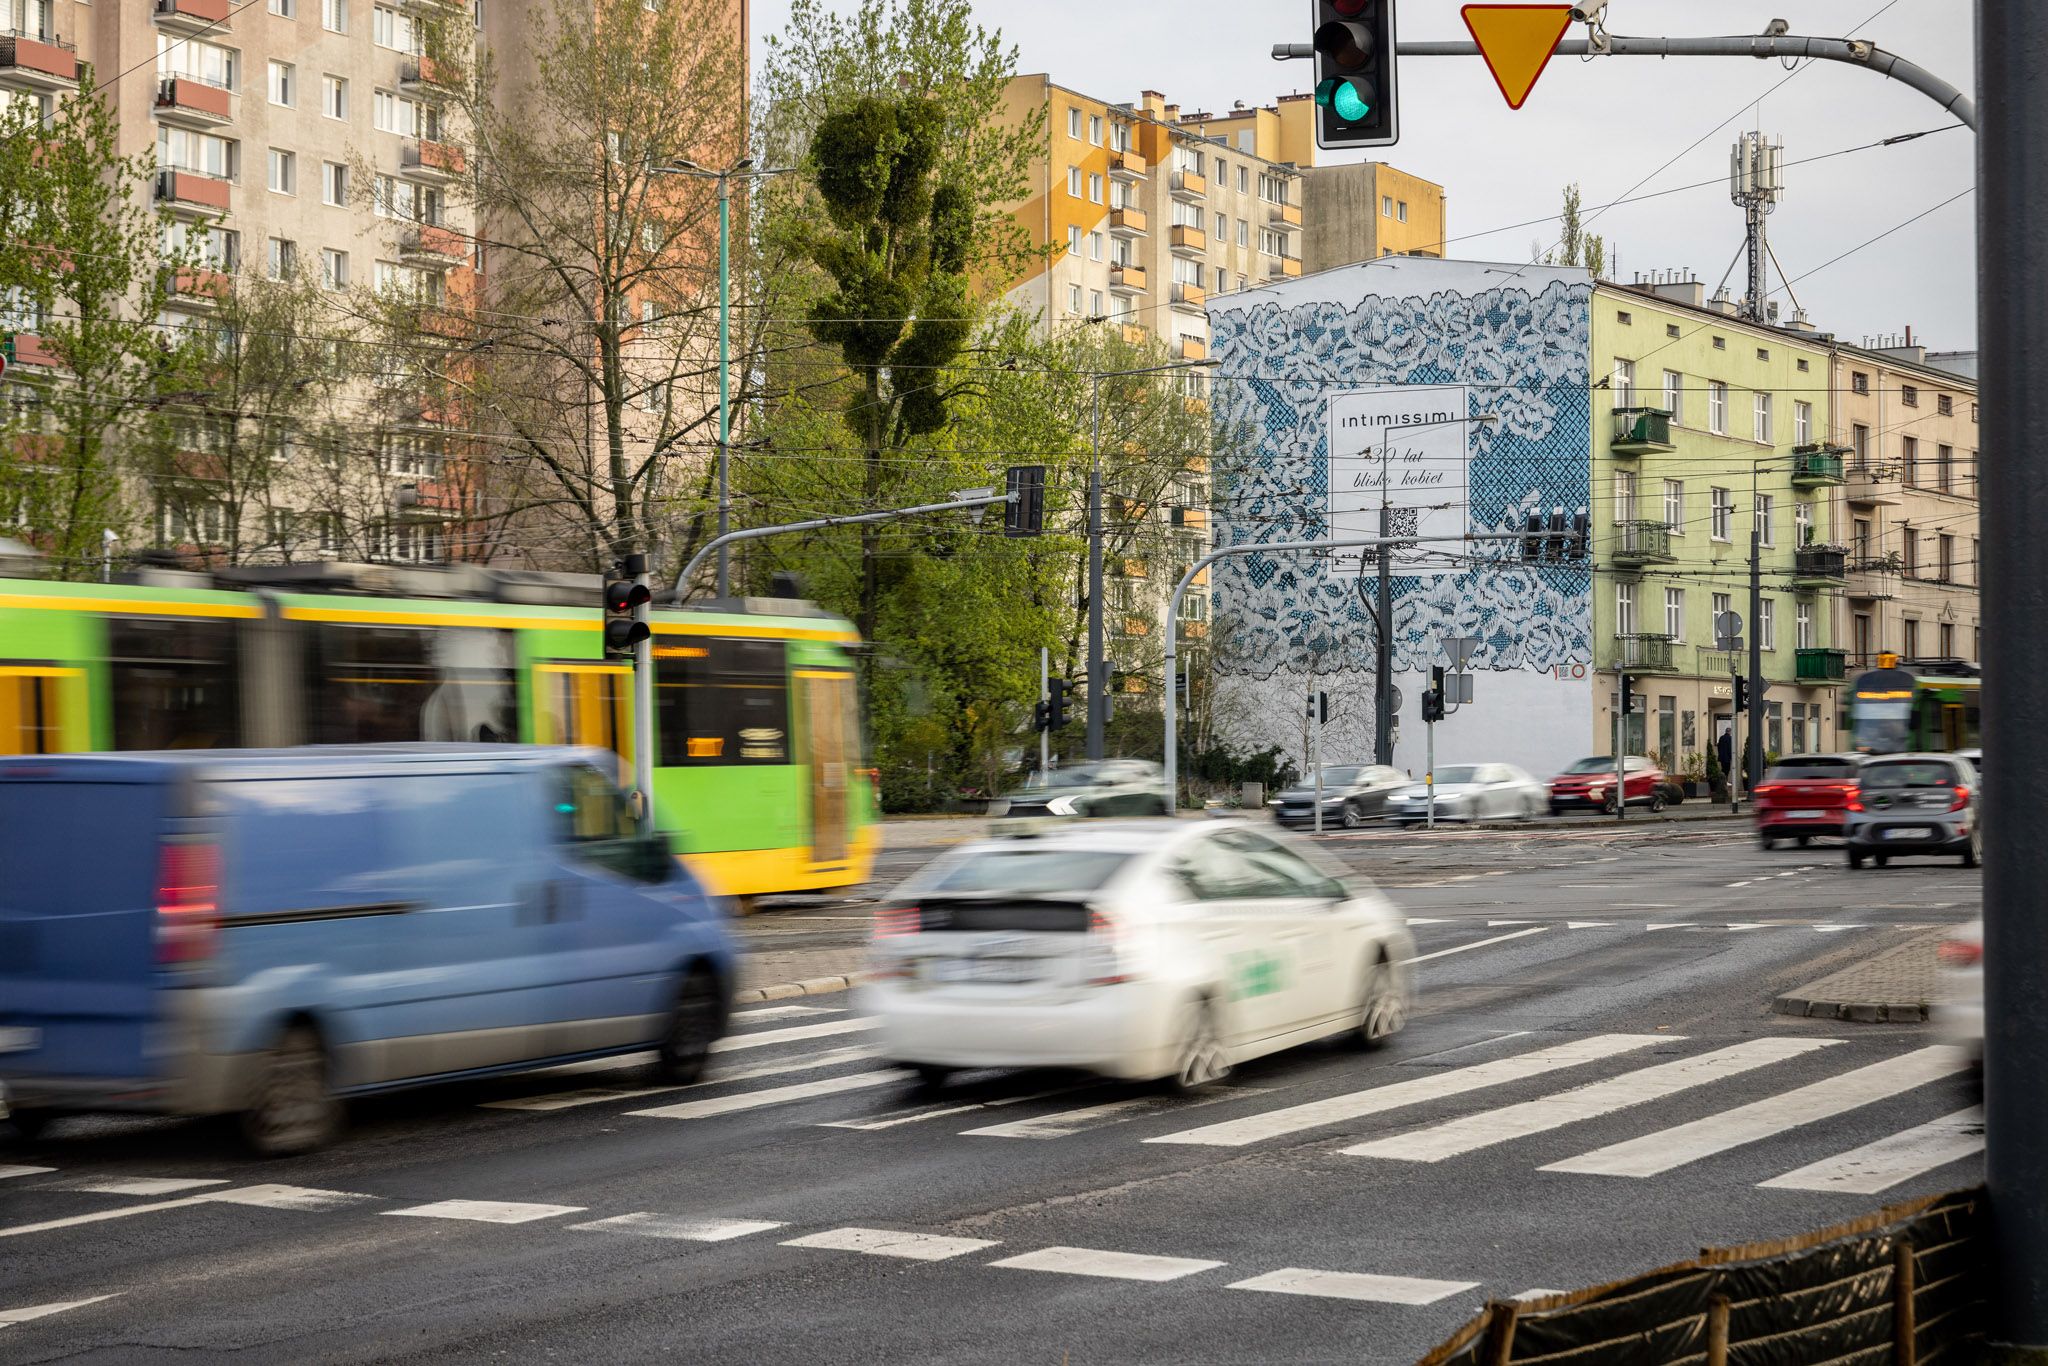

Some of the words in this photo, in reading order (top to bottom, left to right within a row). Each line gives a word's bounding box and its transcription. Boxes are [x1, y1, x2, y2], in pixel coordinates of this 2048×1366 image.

[1342, 411, 1455, 428] intimissimi
[1369, 446, 1397, 465] 30
[1403, 447, 1424, 463] lat
[1353, 471, 1393, 488] blisko
[1401, 469, 1444, 485] kobiet
